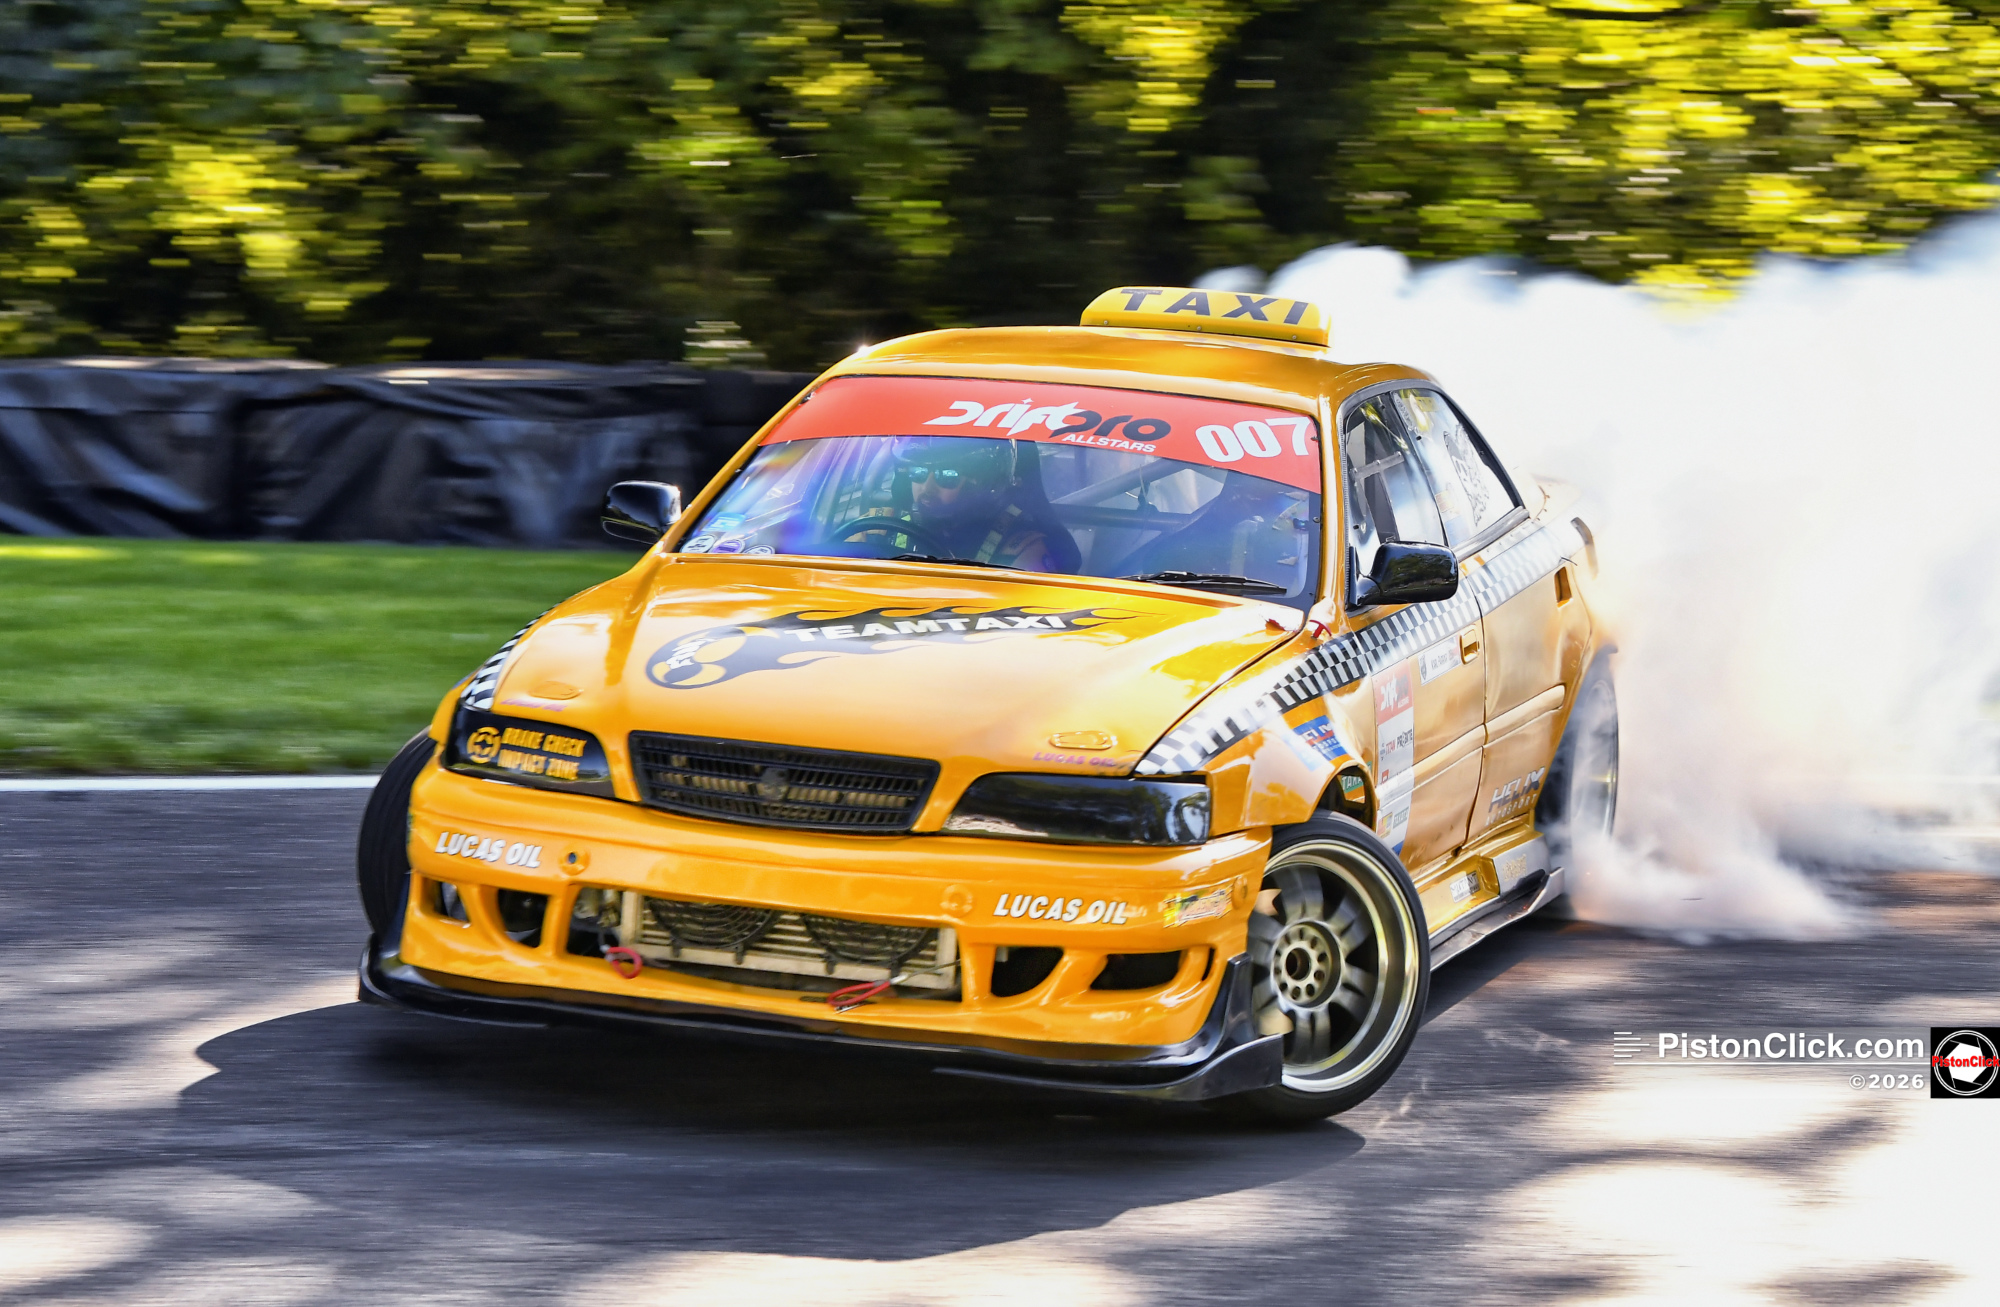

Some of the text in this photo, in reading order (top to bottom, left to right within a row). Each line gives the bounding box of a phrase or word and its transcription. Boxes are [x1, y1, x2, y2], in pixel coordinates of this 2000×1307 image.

[1120, 288, 1308, 325] TAXI
[1062, 433, 1157, 454] ALLSTARS
[1195, 416, 1312, 463] 007
[1032, 751, 1088, 766] LUCAS
[1489, 766, 1546, 813] HELIX
[1485, 793, 1538, 827] AUTOSPORT
[434, 831, 543, 868] LUCAS OIL
[993, 893, 1128, 925] LUCAS OIL
